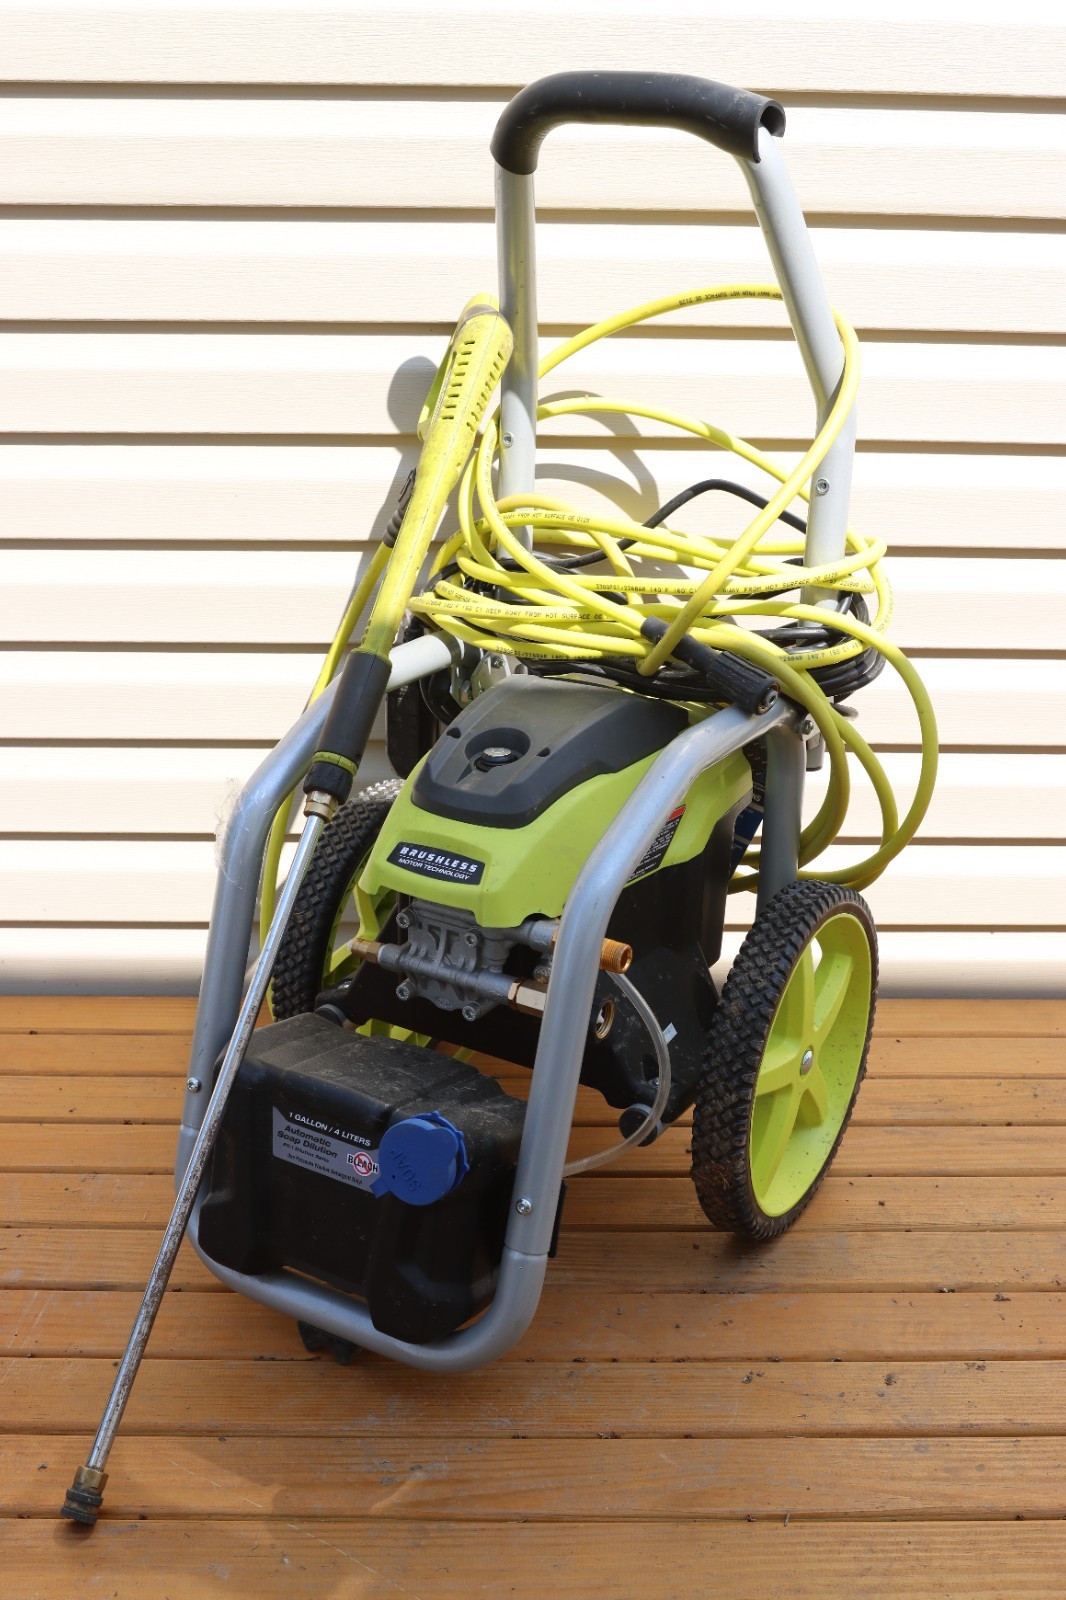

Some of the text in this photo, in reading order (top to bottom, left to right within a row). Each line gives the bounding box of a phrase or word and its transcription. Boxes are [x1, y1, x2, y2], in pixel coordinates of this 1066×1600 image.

[398, 858, 470, 880] MOTOR TECHNOLOGY
[400, 846, 478, 873] BRUSHLESS
[284, 1125, 332, 1148] Automatic
[294, 1114, 328, 1132] GALLON
[341, 1131, 371, 1147] LITERS
[277, 1130, 338, 1158] Soap Dilution
[347, 1154, 378, 1173] BLEACH
